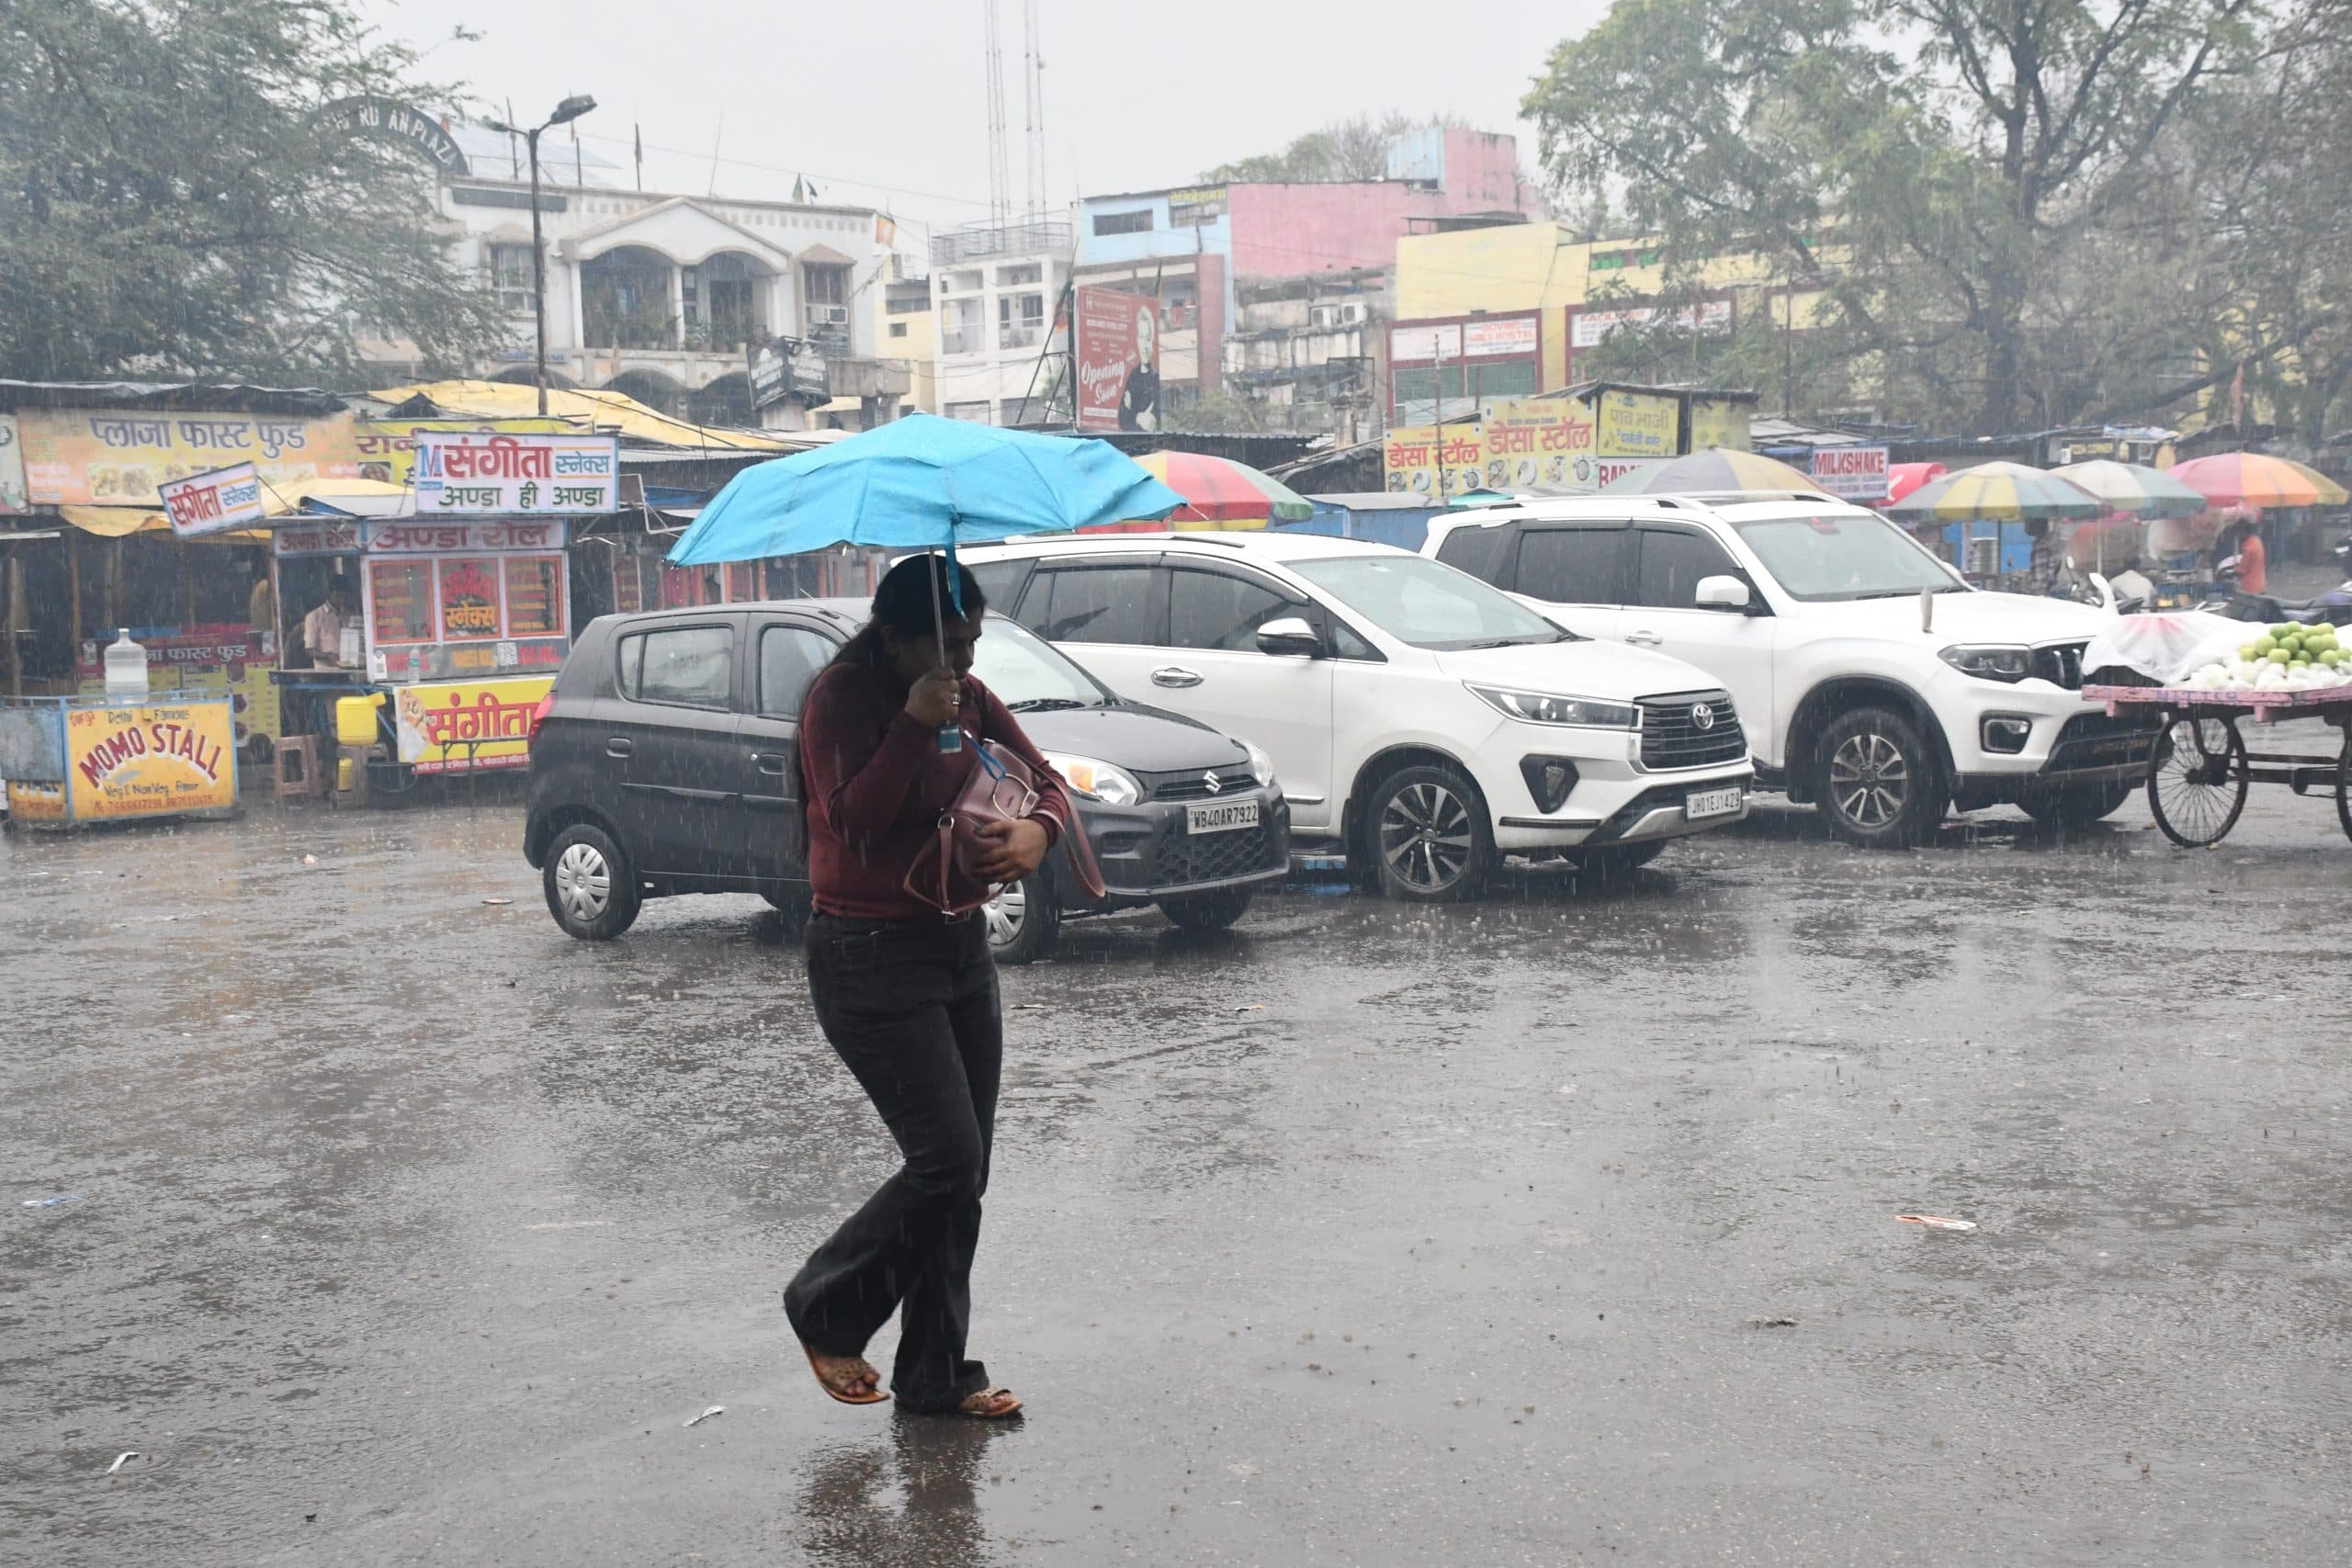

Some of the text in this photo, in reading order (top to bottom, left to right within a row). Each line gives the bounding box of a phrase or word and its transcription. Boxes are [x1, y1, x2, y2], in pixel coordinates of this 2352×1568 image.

[1080, 358, 1125, 390] Opening
[89, 417, 306, 459] प्लाजा फास्ट फुड
[1487, 415, 1593, 456] डोसा स्टॉल
[443, 435, 554, 479] संगीता
[555, 450, 610, 474] स्नेक्स
[1386, 442, 1428, 468] डोसा
[1814, 451, 1884, 476] MILKSHAKE
[167, 483, 257, 526] संगीता स्नेक्स
[438, 486, 503, 507] अण्डा
[518, 481, 539, 509] ही
[552, 486, 605, 506] अण्डा
[375, 524, 471, 549] अण्डा
[425, 692, 540, 746] संगीता
[79, 723, 221, 789] MOMO STALL
[1193, 805, 1258, 829] WB40AR7922
